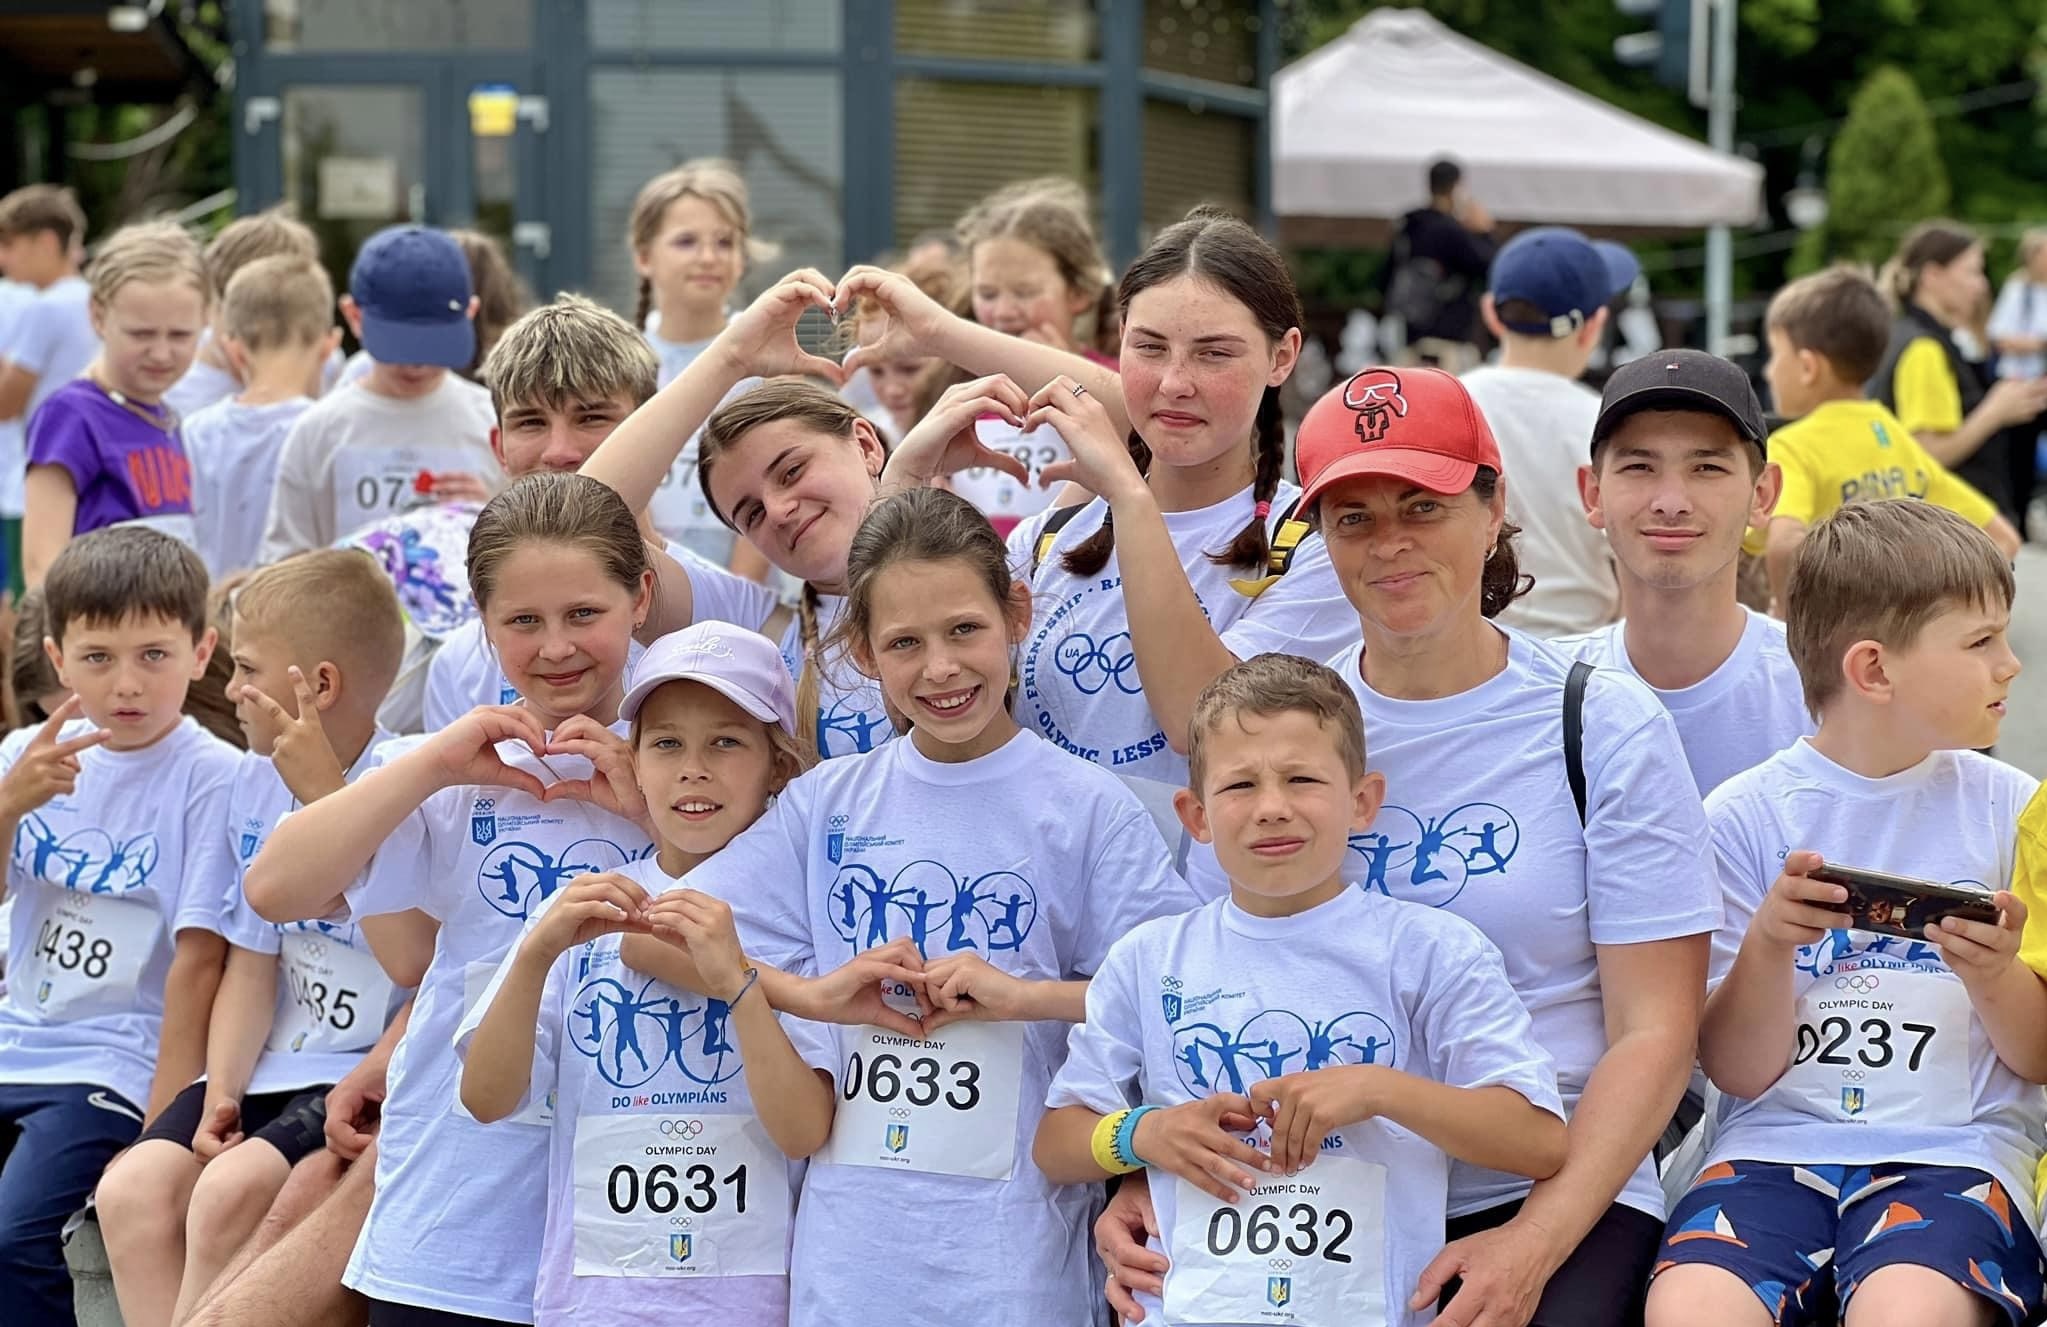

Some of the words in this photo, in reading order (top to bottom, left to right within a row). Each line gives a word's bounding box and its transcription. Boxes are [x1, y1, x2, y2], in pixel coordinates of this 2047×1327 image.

[1025, 592, 1082, 700] FRIENDSHIP
[1065, 648, 1080, 659] UA
[1038, 711, 1100, 764] OLYMPIC
[1112, 731, 1168, 765] LESS
[35, 919, 113, 979] 0438
[1838, 963, 1858, 973] like
[1819, 999, 1869, 1010] OLYMPIC
[1872, 1001, 1894, 1011] DAY
[872, 1034, 921, 1049] OLYMPIC
[924, 1039, 946, 1051] DAY
[1793, 1016, 1937, 1072] 0237
[843, 1051, 981, 1111] 0633
[612, 1095, 631, 1109] DO
[632, 1095, 649, 1107] like
[651, 1091, 728, 1105] OLYMPIANS
[645, 1145, 693, 1156] OLYMPIC
[696, 1146, 718, 1156] DAY
[607, 1163, 747, 1214] 0631
[1250, 1184, 1297, 1196] OLYMPIC
[1300, 1184, 1321, 1196] DAY
[1207, 1203, 1353, 1264] 0632
